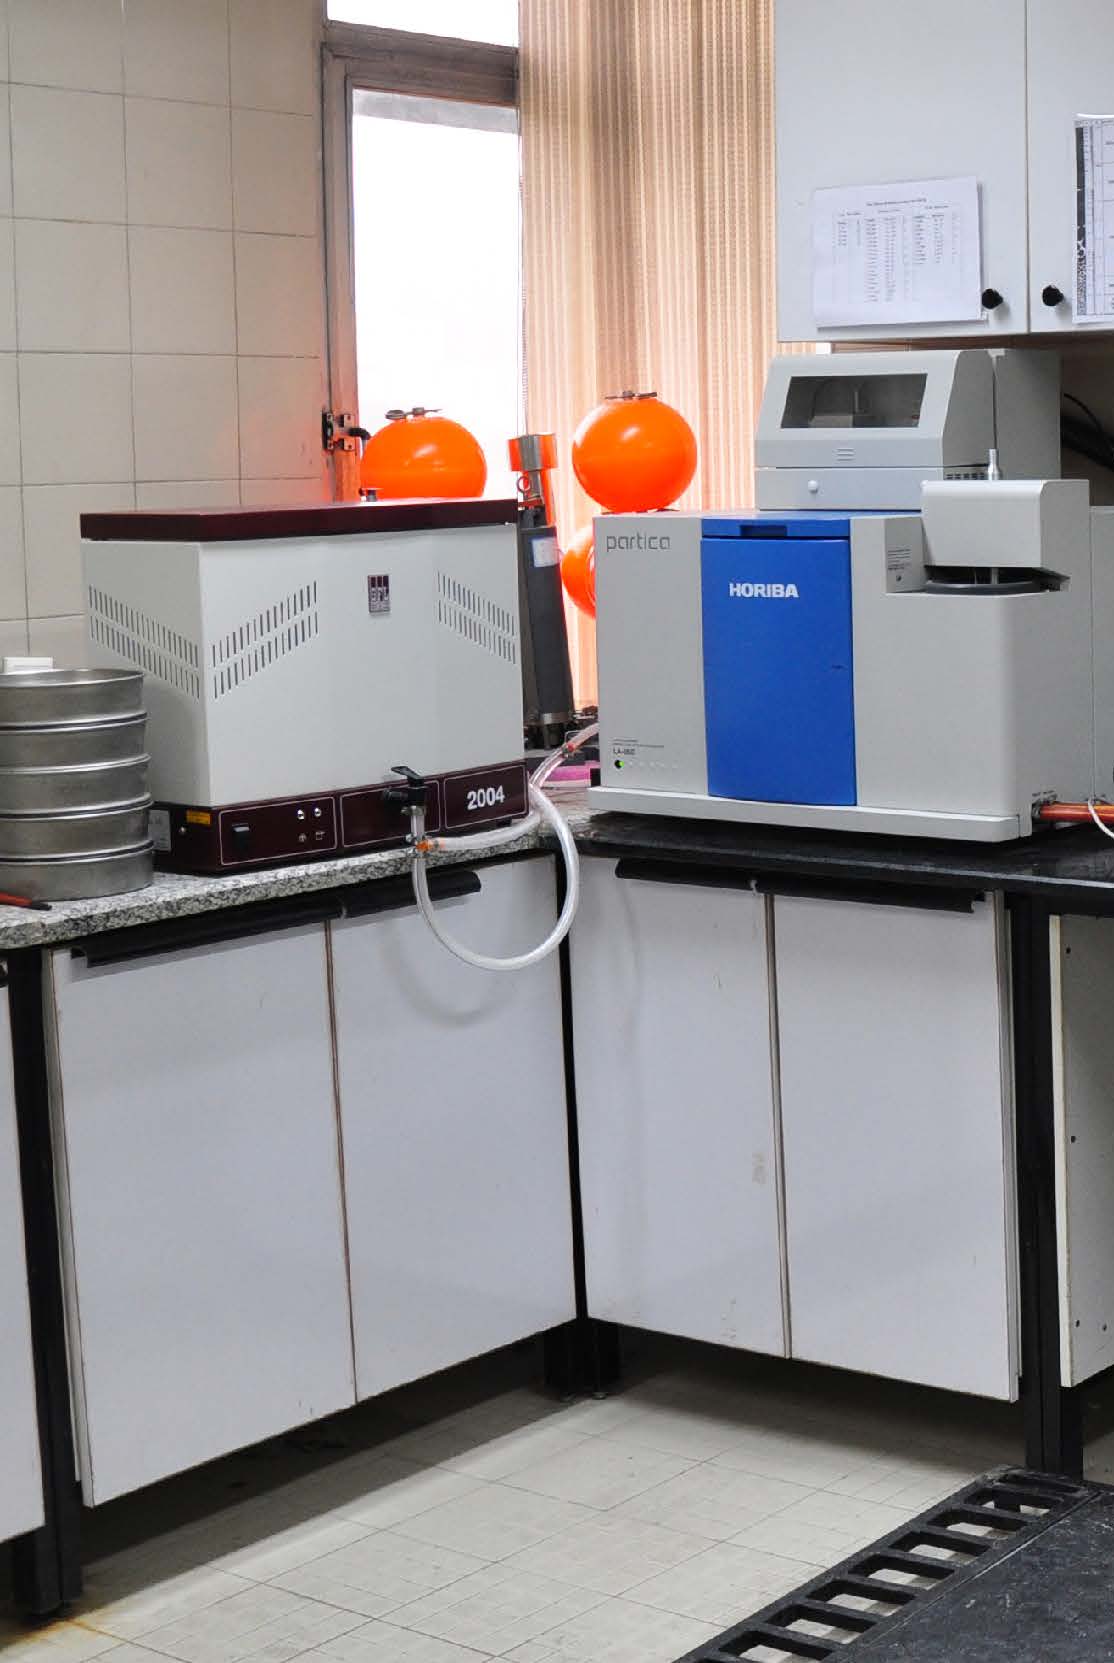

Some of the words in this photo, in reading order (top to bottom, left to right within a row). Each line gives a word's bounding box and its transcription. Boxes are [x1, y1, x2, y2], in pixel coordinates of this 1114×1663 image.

[606, 532, 671, 553] partica
[729, 583, 799, 598] HORIBA
[467, 785, 506, 811] 2004
